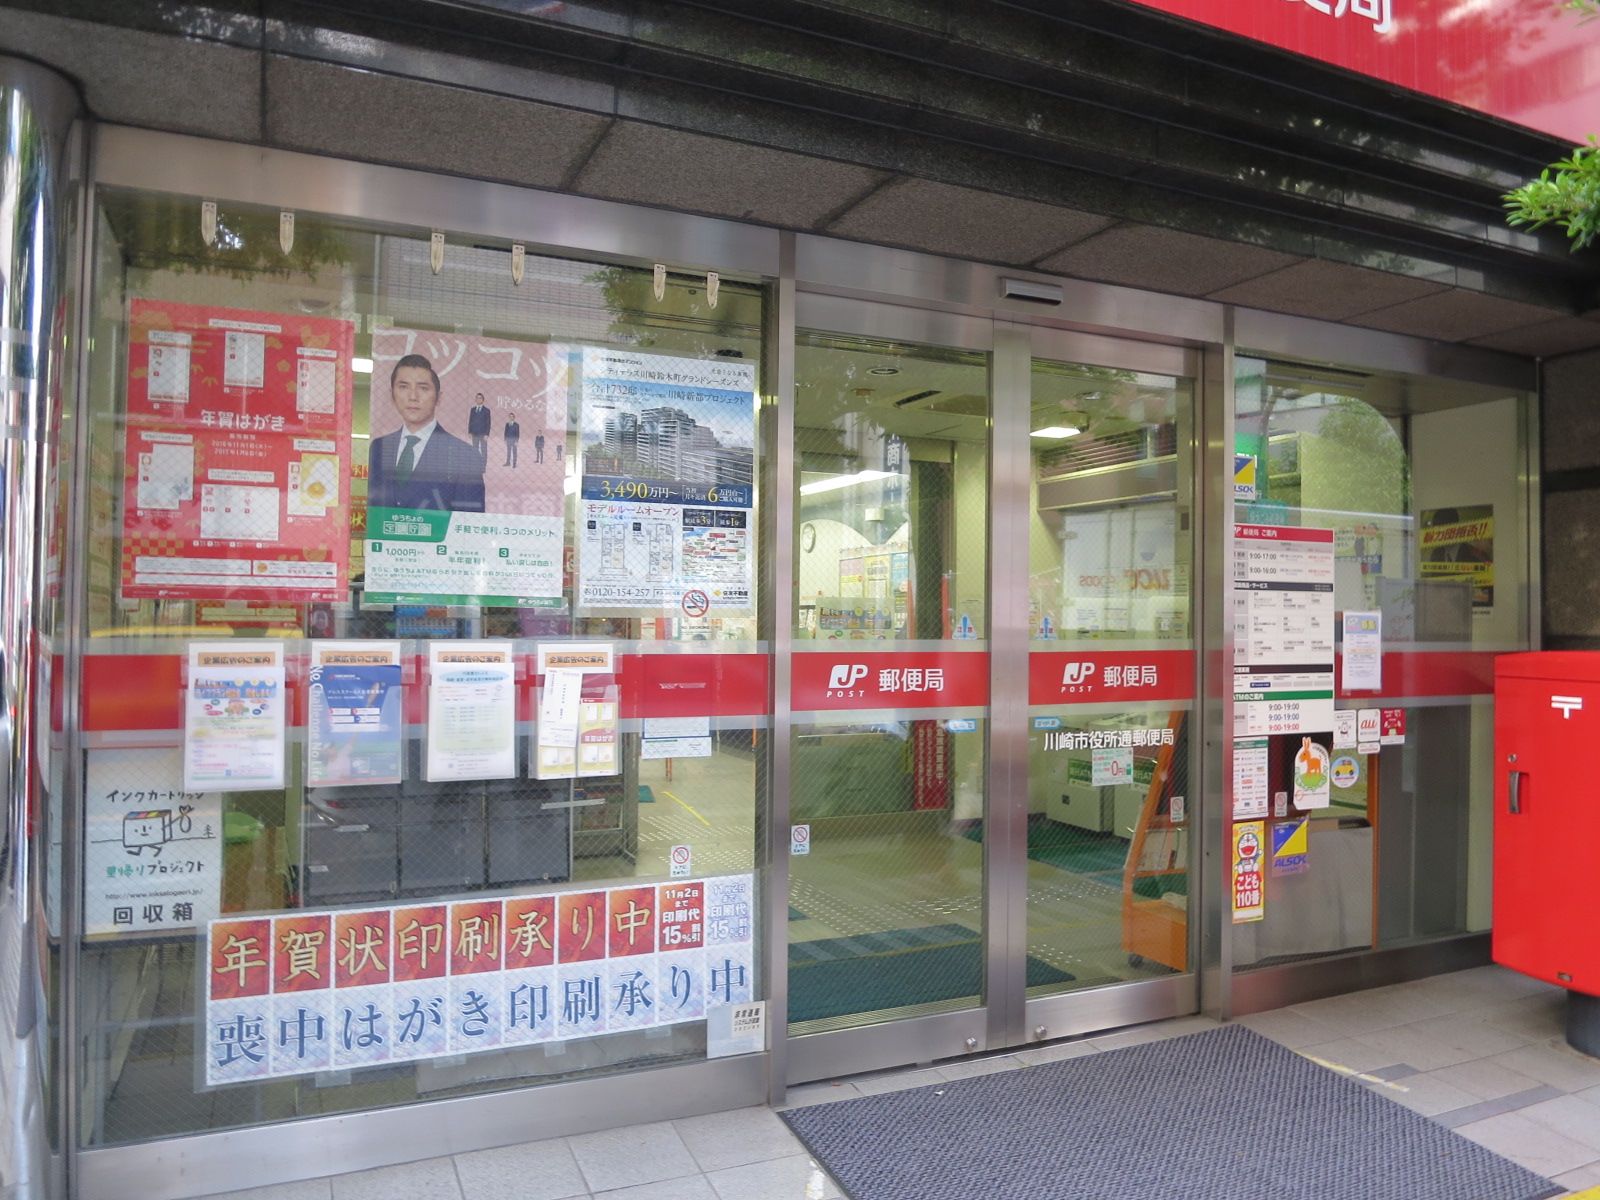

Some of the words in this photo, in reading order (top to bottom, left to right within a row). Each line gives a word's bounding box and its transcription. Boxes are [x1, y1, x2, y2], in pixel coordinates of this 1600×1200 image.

[201, 409, 285, 431] 年賀はがき
[708, 486, 718, 502] 6
[587, 504, 679, 516] モデルルームオープン
[592, 588, 650, 597] 0120-154-257
[879, 668, 944, 692] 郵便局
[1104, 665, 1157, 687] 郵便局
[1061, 685, 1092, 693] POST
[1361, 719, 1377, 729] au
[1044, 729, 1174, 751] 川崎市役所通郵便局
[1274, 855, 1307, 867] ALSOK
[106, 861, 204, 878] 里帰りプロジェクト
[1236, 874, 1260, 890] こども
[665, 888, 699, 899] 11月2日
[1236, 890, 1260, 907] 110番
[114, 902, 193, 925] 回収箱
[663, 908, 700, 923] 印刷代
[214, 899, 651, 988] 年賀状印刷承り中
[215, 959, 745, 1068] 喪中はがき印刷承り中
